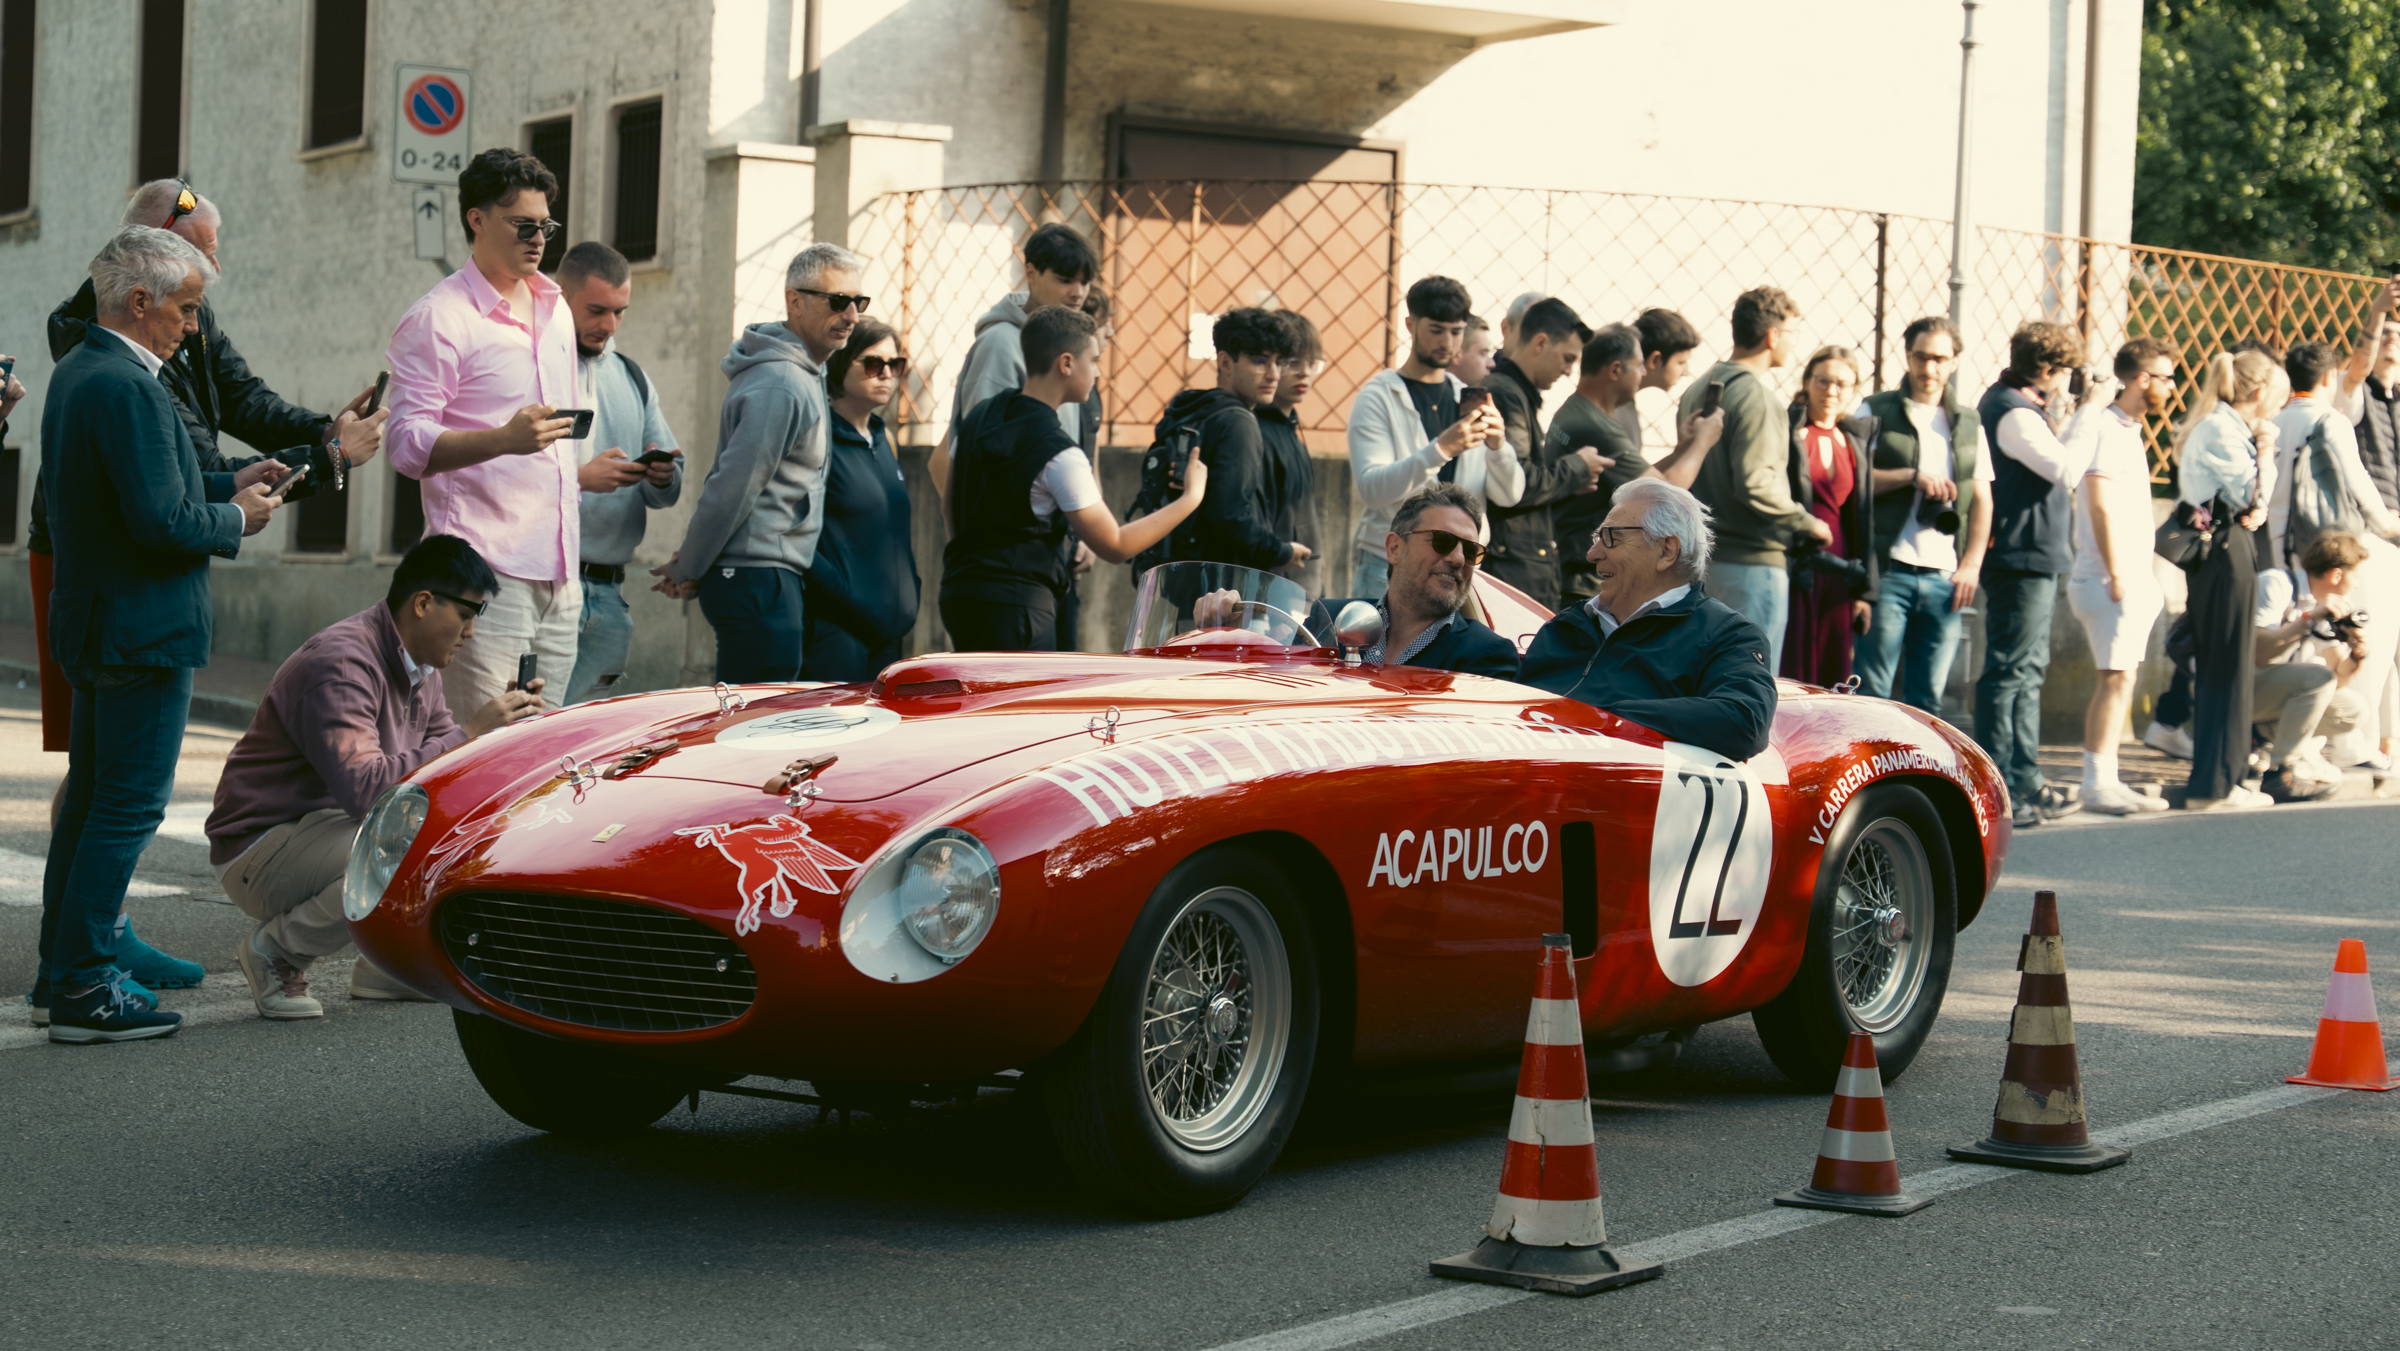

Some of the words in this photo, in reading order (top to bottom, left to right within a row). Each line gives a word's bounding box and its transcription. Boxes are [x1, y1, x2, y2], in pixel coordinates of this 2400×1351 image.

[1032, 731, 1258, 827] HOTEL
[1808, 825, 1825, 845] V
[1818, 759, 1874, 830] CARRERA
[1367, 820, 1549, 888] ACAPULCO
[1669, 761, 1749, 940] 22
